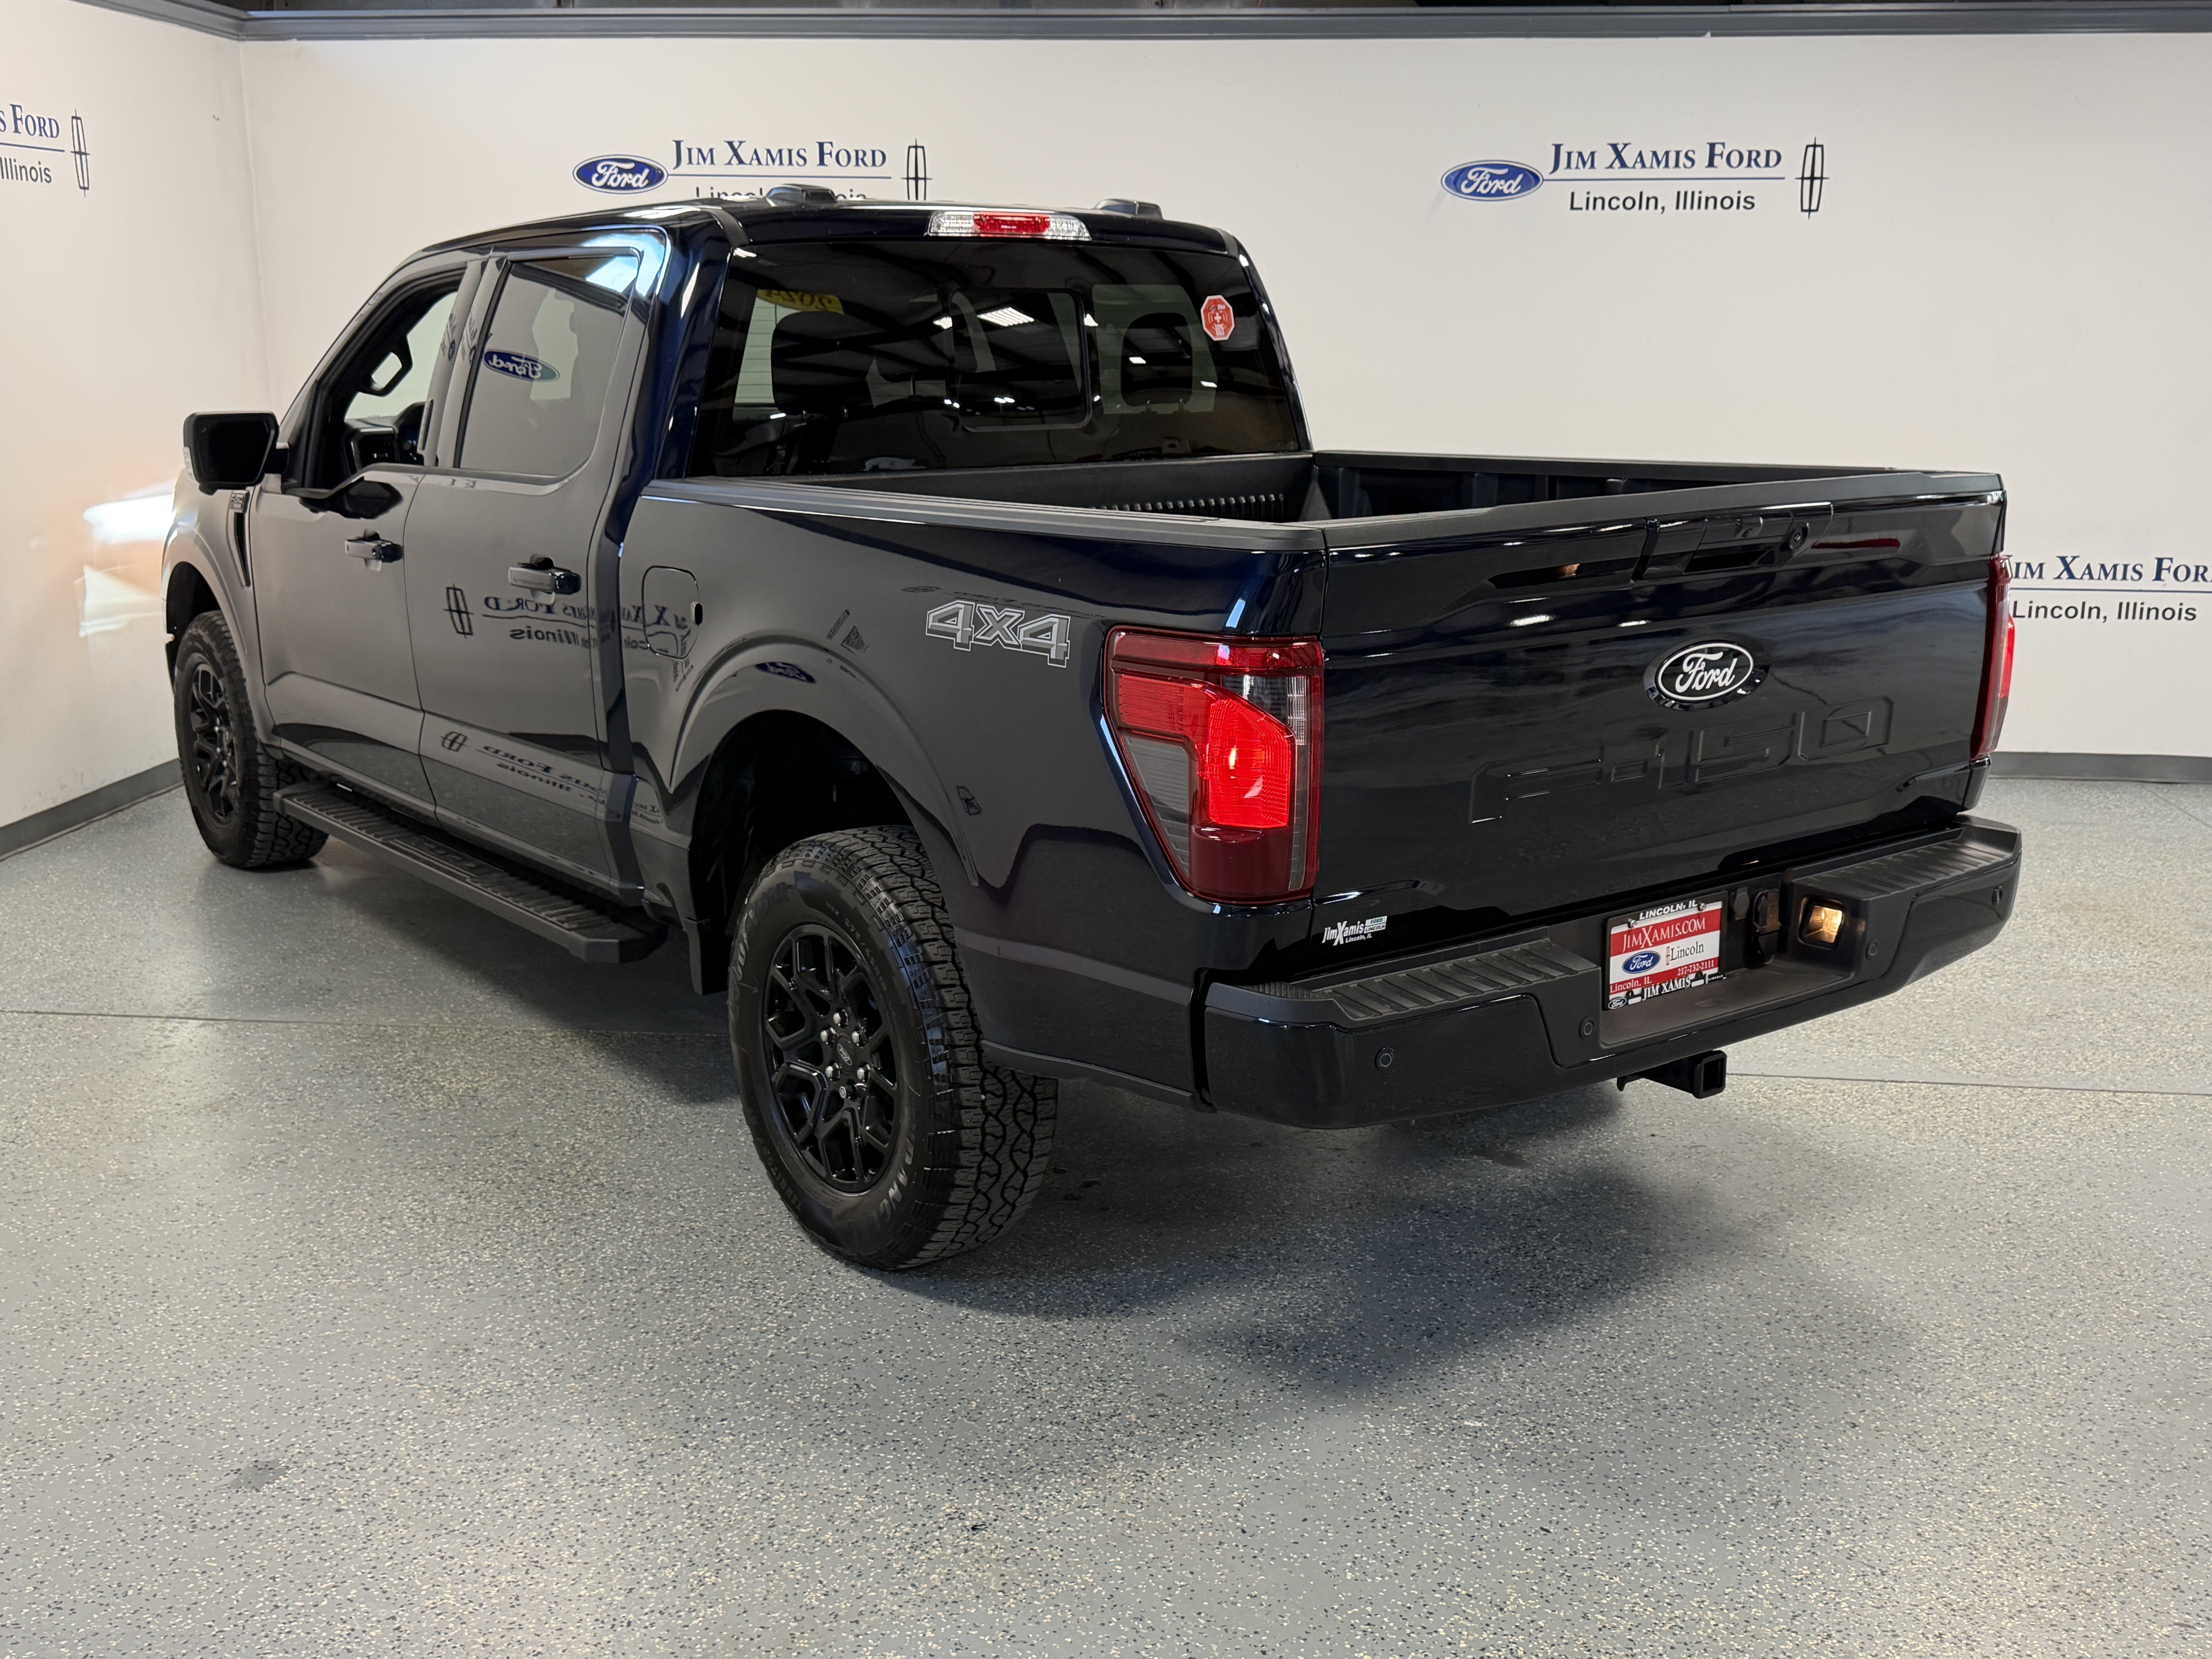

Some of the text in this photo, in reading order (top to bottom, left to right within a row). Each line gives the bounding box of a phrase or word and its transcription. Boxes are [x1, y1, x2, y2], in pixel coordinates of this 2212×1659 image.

[10, 104, 60, 138] FORD
[673, 140, 886, 170] JIM XAMIS FORD
[1549, 142, 1782, 175] JIM XAMIS FORD
[591, 161, 649, 187] Ford
[1461, 167, 1523, 194] Ford
[1570, 191, 1755, 214] Lincoln, Illinois
[2002, 554, 2212, 582] IM XAMIS FOR
[2013, 600, 2197, 623] Lincoln, Illinois
[1676, 652, 1738, 692] Ford
[1688, 900, 1698, 908] IL
[1623, 917, 1705, 953] JIMXAMIS.COM
[1630, 955, 1654, 970] Ford
[1670, 941, 1704, 961] Lincoln
[1642, 975, 1691, 1001] JIM XAMIS
[1644, 976, 1652, 985] IL
